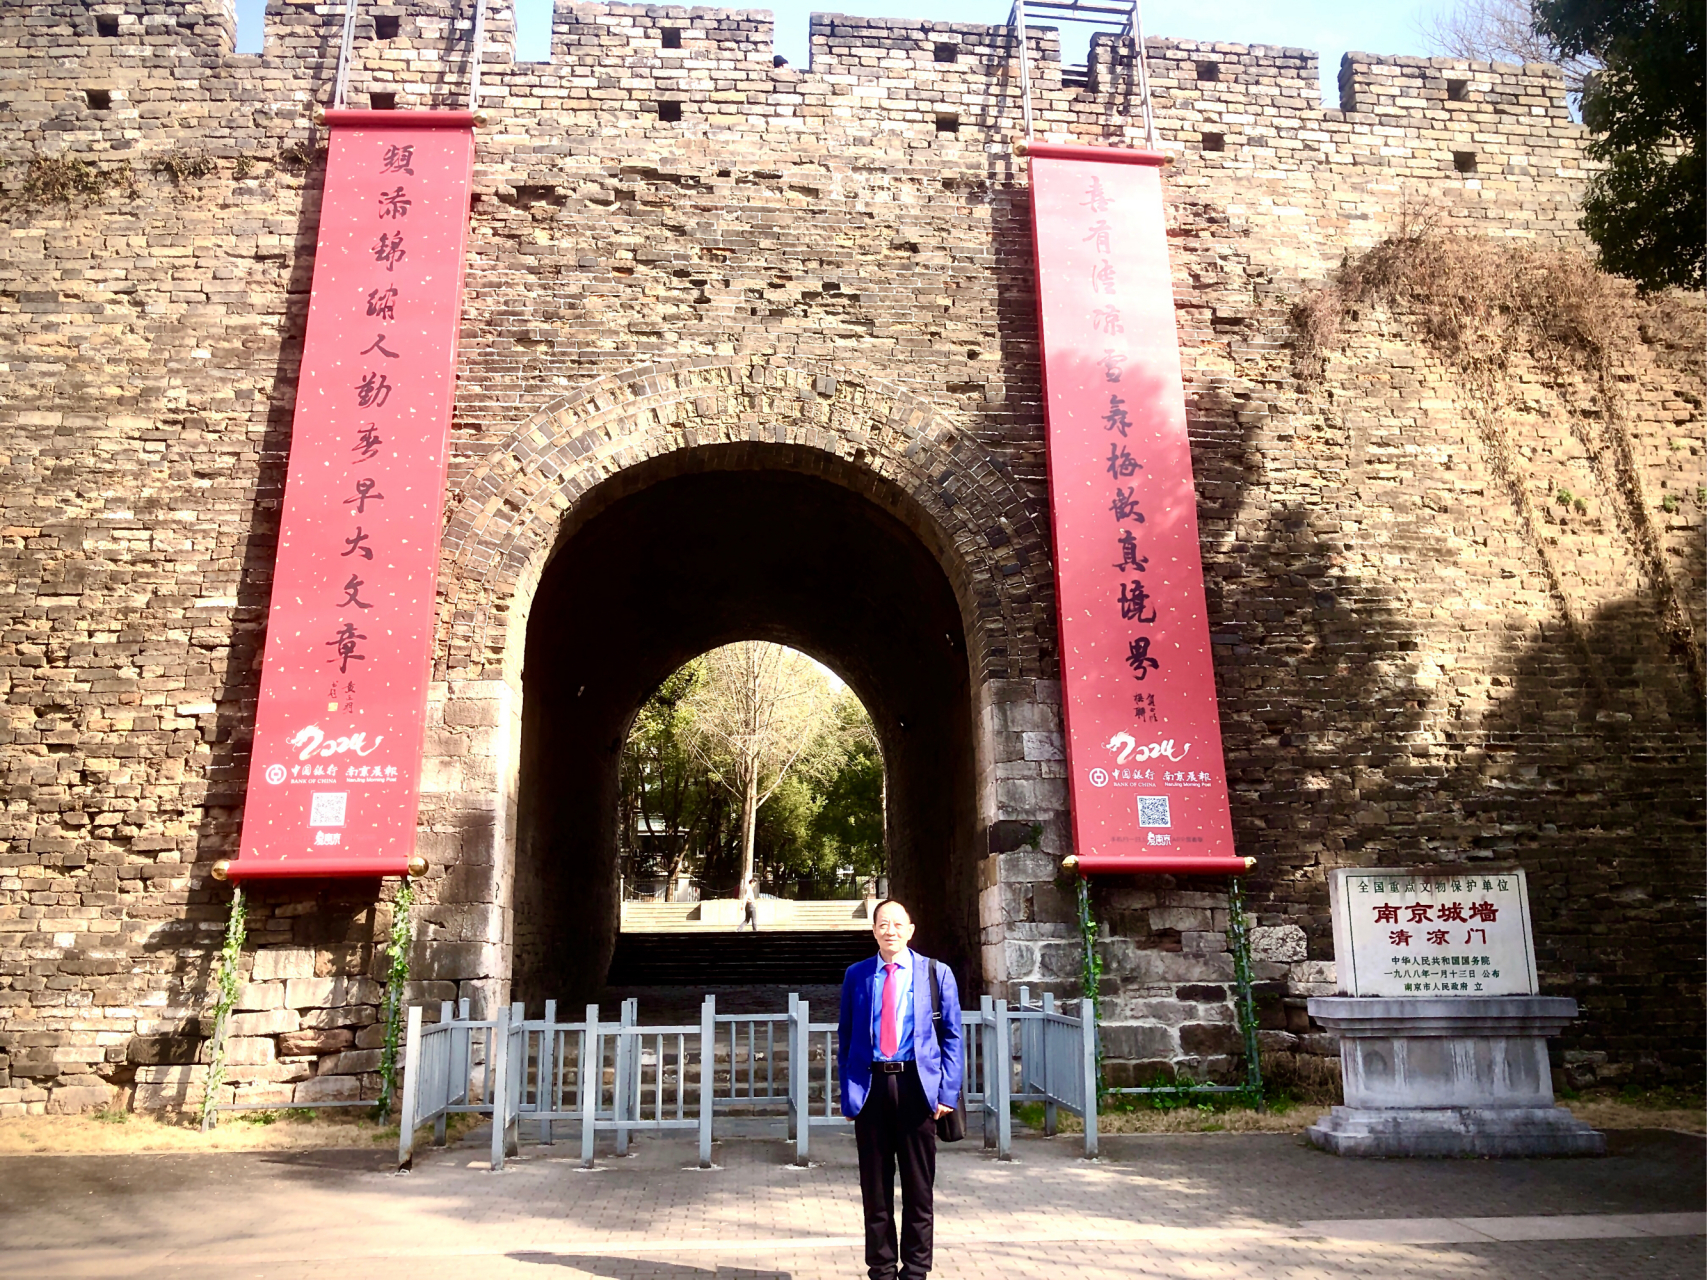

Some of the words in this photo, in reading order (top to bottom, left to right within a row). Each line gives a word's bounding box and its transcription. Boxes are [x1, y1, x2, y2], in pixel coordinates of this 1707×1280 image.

[286, 722, 384, 761] 2024
[1101, 728, 1192, 765] 2024
[1357, 879, 1510, 894] 全国重点文物保护单位
[1372, 900, 1499, 924] 南京城墙
[1388, 928, 1487, 947] 清凉门
[1391, 956, 1491, 966] 中华人民共和国国务院
[1384, 969, 1476, 979] 一九八八年一月十三日
[1481, 969, 1500, 979] 公布
[1404, 982, 1468, 992] 南京市人民政府
[1474, 982, 1484, 991] 立
